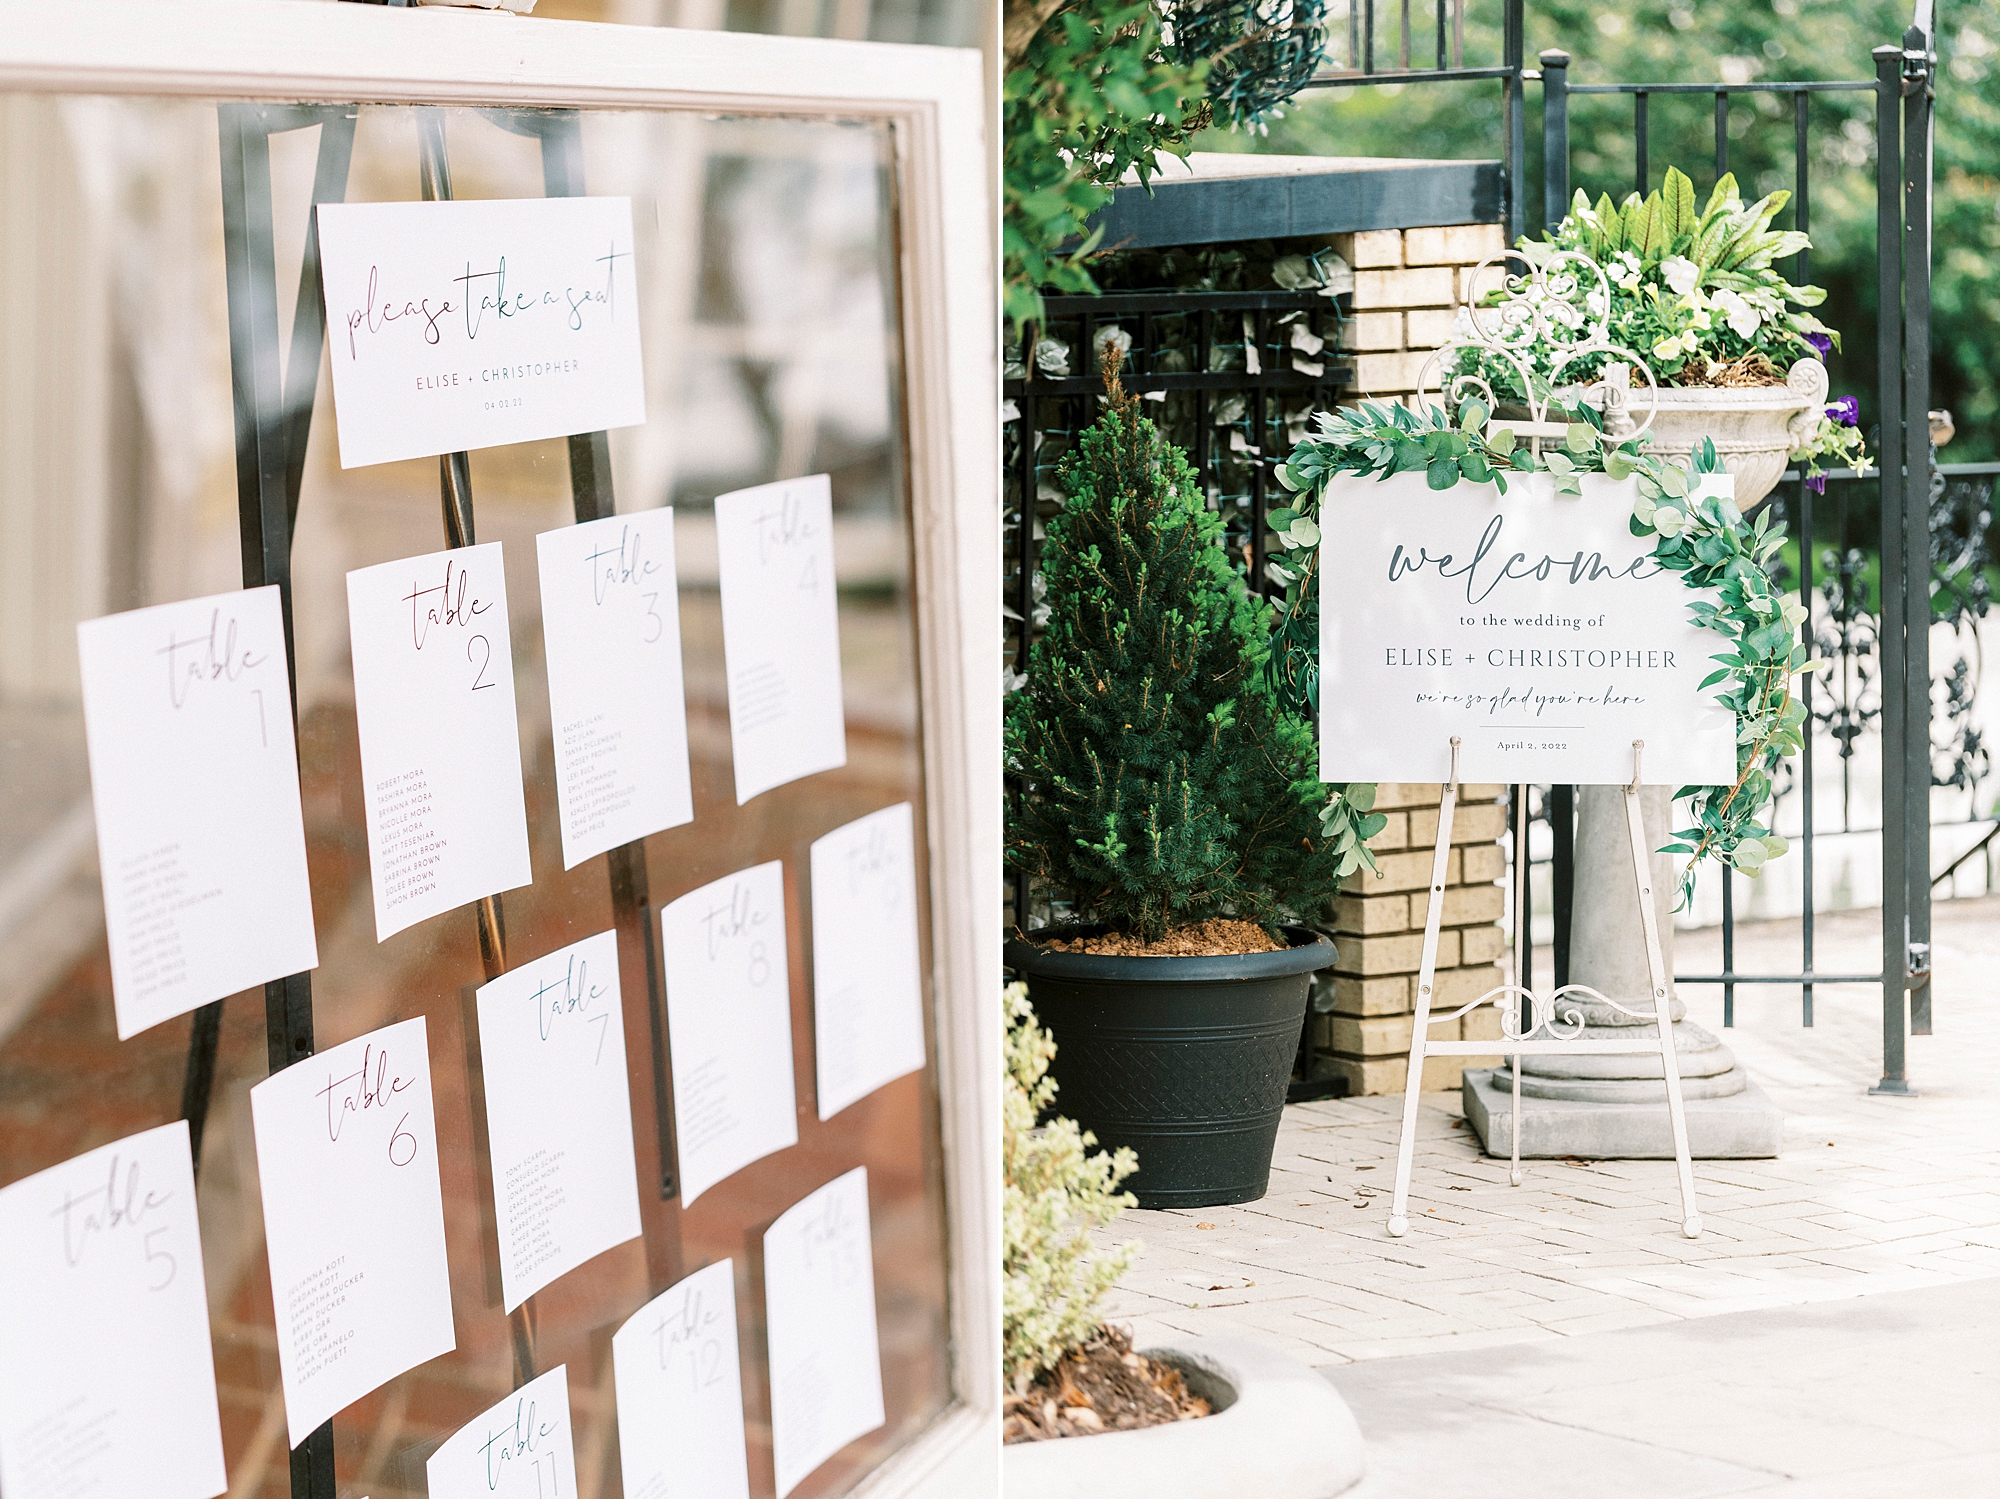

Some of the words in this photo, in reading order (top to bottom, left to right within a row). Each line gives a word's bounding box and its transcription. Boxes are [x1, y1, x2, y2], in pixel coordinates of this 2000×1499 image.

[346, 265, 459, 361] please
[453, 255, 537, 340] take
[543, 290, 560, 305] a
[566, 239, 633, 331] seat
[416, 373, 460, 391] ELISE
[482, 359, 580, 383] CHRISTOPHER
[484, 398, 523, 411] 04.02.22
[752, 490, 820, 567] table
[584, 524, 664, 606] table
[799, 553, 818, 598] 4
[1388, 514, 1666, 605] welcome
[402, 560, 494, 651] table
[641, 592, 663, 644] 3
[1460, 615, 1475, 626] to
[1482, 614, 1507, 626] the
[1513, 614, 1582, 631] wedding
[1588, 614, 1606, 627] of
[155, 607, 270, 710] table
[467, 634, 496, 691] 2
[1385, 647, 1453, 667] ELISE
[1465, 653, 1476, 665] +
[1487, 649, 1678, 669] CHRISTOPHER
[1416, 690, 1463, 703] we're
[1464, 694, 1486, 709] so
[1489, 686, 1533, 714] glad
[1535, 690, 1599, 717] you're
[1603, 685, 1646, 706] here
[250, 688, 268, 749] 1
[562, 720, 584, 734] RACHEL
[564, 734, 577, 746] AZIZ
[564, 746, 582, 758] TANYA
[1497, 741, 1523, 751] April
[376, 776, 400, 790] ROBERT
[403, 768, 424, 780] MORA
[566, 755, 589, 770] LINDSEY
[567, 771, 580, 782] LEXI
[580, 764, 594, 776] BUCK
[378, 789, 404, 804] TASHIRA
[406, 780, 428, 792] MORA
[568, 782, 584, 794] EMILY
[586, 768, 618, 784] MCMAHON
[378, 800, 410, 818] BRYANNA
[411, 792, 433, 804] MORA
[569, 795, 583, 805] RYAN
[570, 803, 590, 817] ASHLEY
[380, 813, 408, 830] NICOLLE
[410, 806, 432, 818] MORA
[381, 829, 402, 845] LEXUS
[402, 821, 424, 834] MORA
[572, 829, 588, 840] NOAH
[589, 820, 606, 831] PRICE
[382, 843, 400, 858] MATT
[400, 830, 436, 849] TESENIAR
[383, 850, 418, 872] JONATHAN
[420, 839, 448, 854] BROWN
[384, 866, 412, 884] SABRINA
[414, 854, 441, 870] BROWN
[386, 880, 406, 896] SOLEE
[408, 870, 435, 886] BROWN
[386, 893, 408, 910] SIMON
[410, 882, 437, 898] BROWN
[701, 881, 770, 962] table
[748, 939, 770, 988] 8
[529, 954, 609, 1041] table
[587, 1013, 609, 1066] 7
[315, 1043, 416, 1142] table
[388, 1112, 417, 1167] 6
[505, 1162, 522, 1178] TONY
[523, 1148, 546, 1167] SCARPA
[506, 1164, 539, 1190] CONSUELO
[541, 1150, 564, 1168] SCARPA
[508, 1178, 539, 1203] JONATHAN
[541, 1165, 560, 1179] MORA
[509, 1195, 527, 1213] GRACE
[529, 1184, 548, 1198] MORA
[49, 1153, 176, 1268] table
[510, 1198, 542, 1224] KATHERINE
[544, 1186, 564, 1200] MORA
[510, 1213, 536, 1236] GARRETT
[537, 1196, 566, 1218] STROUPE
[512, 1230, 530, 1247] AIMEE
[531, 1218, 550, 1232] MORA
[512, 1242, 530, 1259] MILEY
[532, 1230, 550, 1244] MORA
[144, 1226, 178, 1292] 5
[326, 1254, 346, 1272] KOTT
[514, 1252, 533, 1270] ISAIAH
[534, 1240, 552, 1254] MORA
[515, 1264, 532, 1282] TYLER
[534, 1245, 562, 1268] STROUPE
[289, 1286, 317, 1311] JORDAN
[320, 1272, 339, 1289] KOTT
[290, 1291, 330, 1322] SAMANTHA
[332, 1272, 364, 1295] DUCKER
[292, 1315, 314, 1336] BRIAN
[316, 1294, 346, 1319] DUCKER
[316, 1316, 331, 1332] ORR
[651, 1285, 725, 1371] table
[295, 1343, 310, 1362] JAKE
[312, 1332, 328, 1347] ORR
[296, 1354, 316, 1373] ALMA
[317, 1329, 354, 1358] CHANELO
[298, 1362, 322, 1386] AARON
[324, 1346, 347, 1367] PUETT
[685, 1338, 725, 1394] 12
[478, 1397, 559, 1491] table
[531, 1451, 558, 1499] 11
